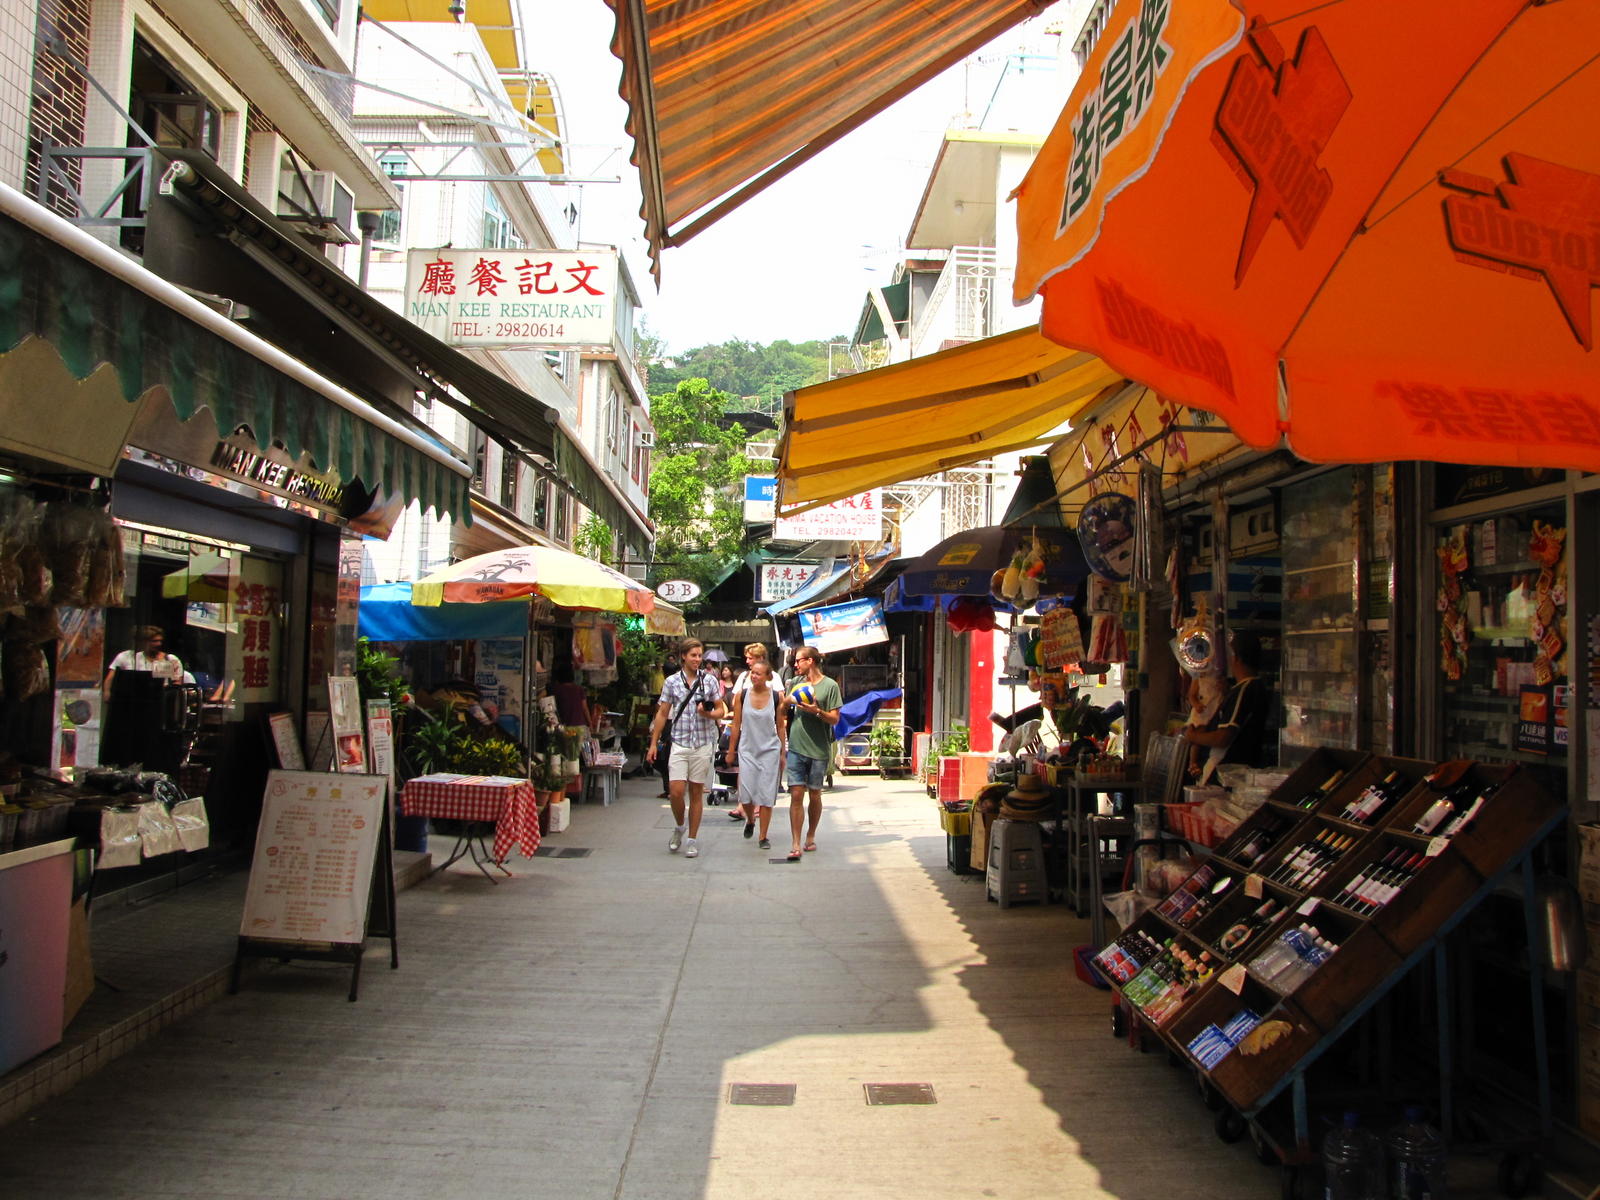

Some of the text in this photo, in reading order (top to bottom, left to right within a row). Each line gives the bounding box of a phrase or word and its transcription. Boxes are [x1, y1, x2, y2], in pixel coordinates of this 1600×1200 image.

[411, 302, 606, 319] MAN KEE RESTAURANT
[495, 323, 564, 338] 29820614
[213, 442, 343, 507] MAN KEE RESTAURA
[851, 513, 877, 525] HOUSE
[766, 566, 815, 581] 永光士
[1556, 731, 1568, 741] VIS
